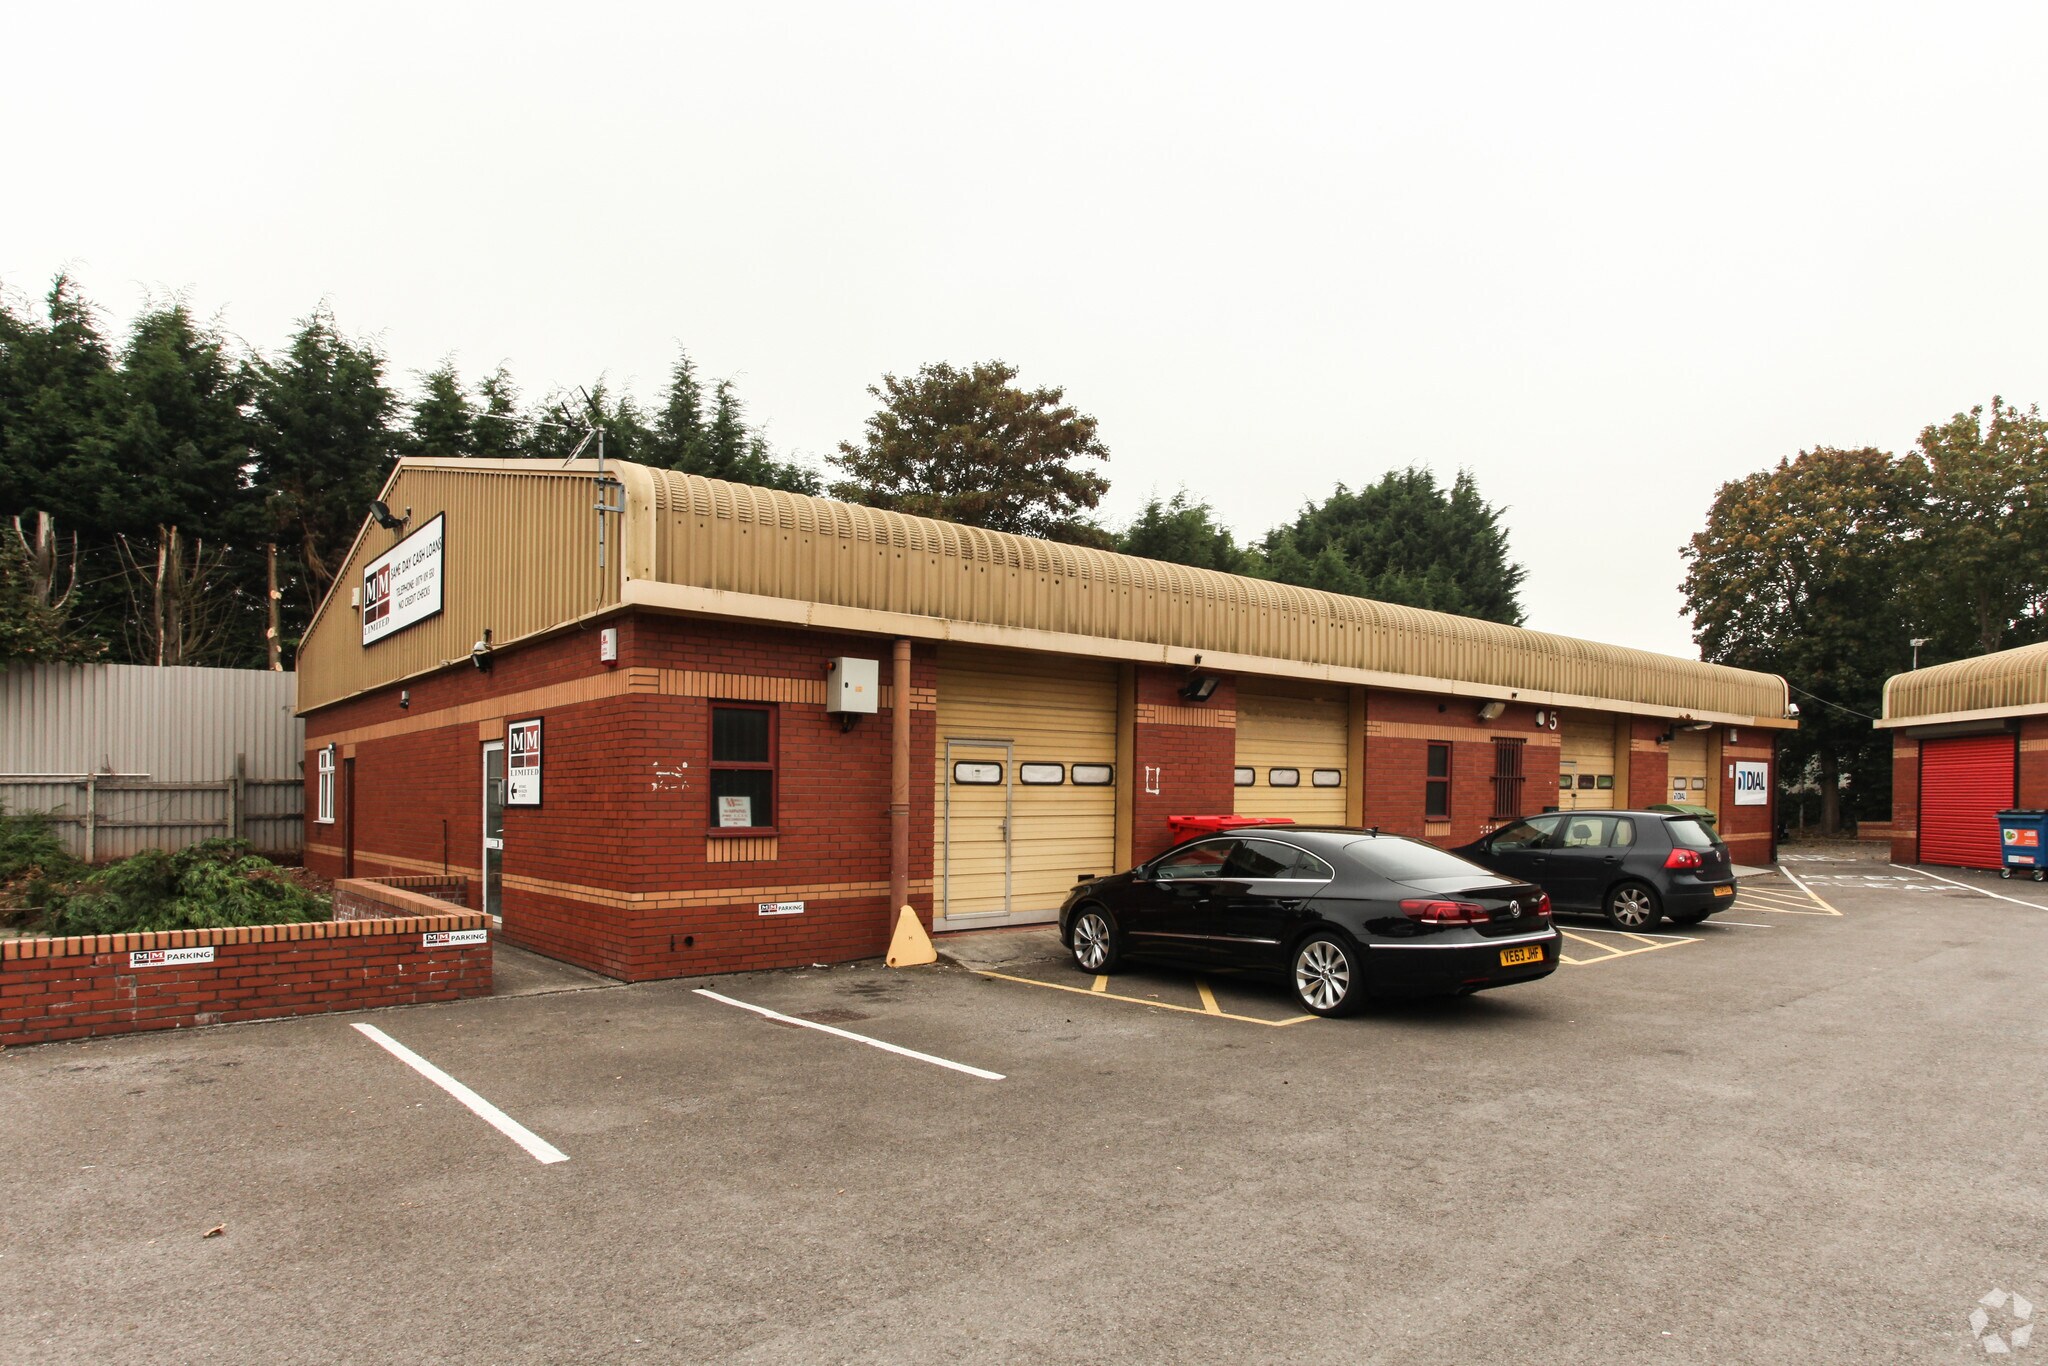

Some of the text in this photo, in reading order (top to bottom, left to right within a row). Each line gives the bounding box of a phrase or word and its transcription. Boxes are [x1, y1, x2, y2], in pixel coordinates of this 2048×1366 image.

[391, 562, 401, 580] SAME
[402, 556, 411, 573] DAY
[412, 547, 425, 566] CASH
[426, 537, 442, 558] LOANS
[398, 599, 404, 609] NO
[364, 617, 390, 635] LIMITED
[1549, 711, 1557, 730] 5
[511, 768, 539, 776] LIMITED
[1747, 771, 1765, 790] DIAL
[167, 951, 211, 961] PARKING
[1504, 946, 1539, 963] VE63 JHF
